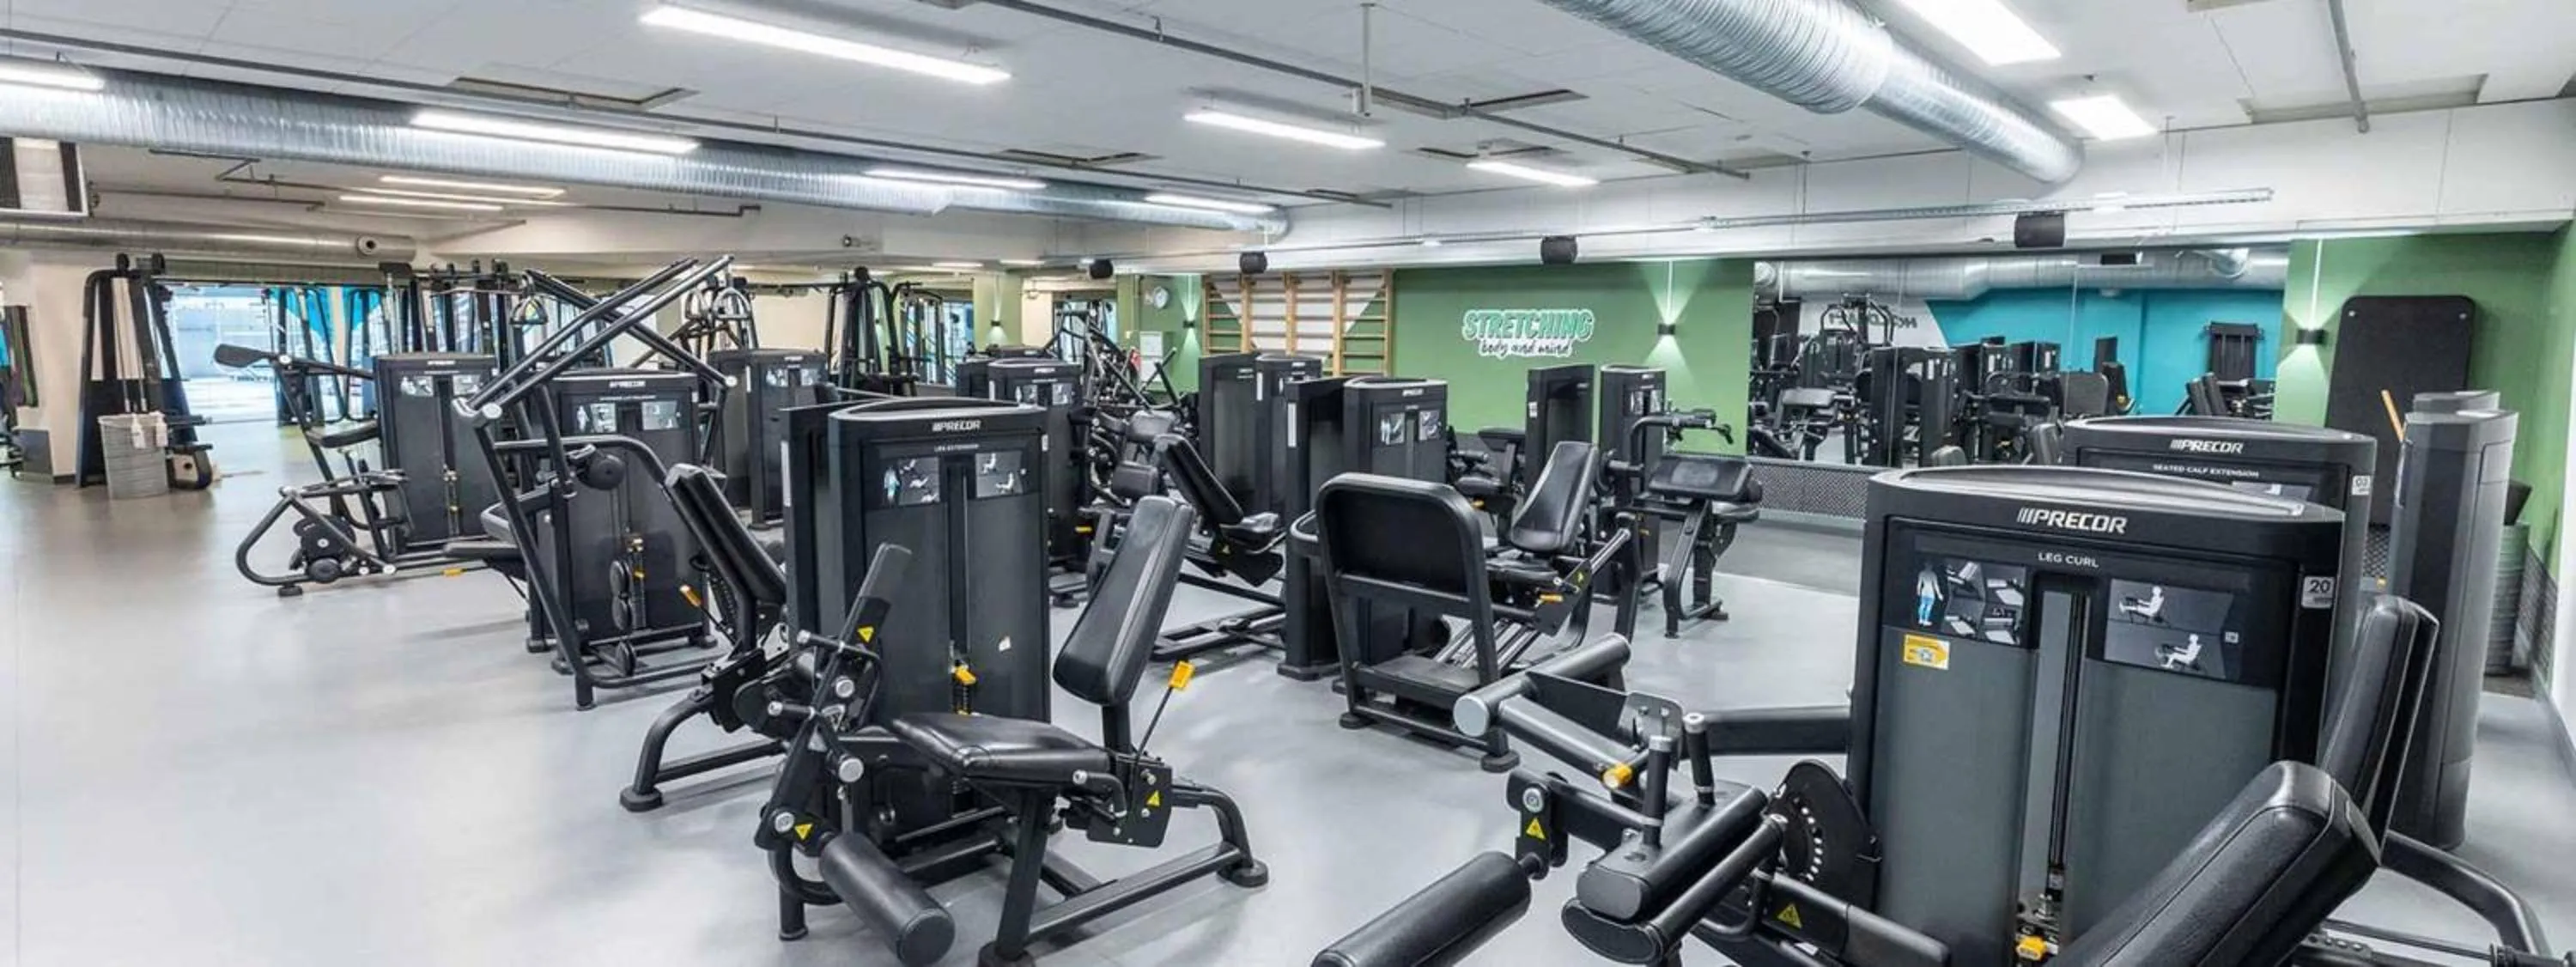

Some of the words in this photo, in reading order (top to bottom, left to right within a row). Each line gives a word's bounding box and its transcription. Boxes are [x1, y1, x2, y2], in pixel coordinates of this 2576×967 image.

[1463, 310, 1594, 341] STRETCHING
[1481, 342, 1509, 356] body
[1511, 344, 1534, 354] and
[1538, 344, 1570, 354] mind
[940, 419, 981, 431] PRECOR
[2180, 439, 2245, 454] PRECOR
[2152, 464, 2185, 472] SEATED
[2209, 468, 2260, 478] EXTENSION
[2032, 508, 2129, 534] PRECOR
[2038, 552, 2063, 563] LEG
[2064, 555, 2100, 569] CURL
[2308, 579, 2331, 593] 20
